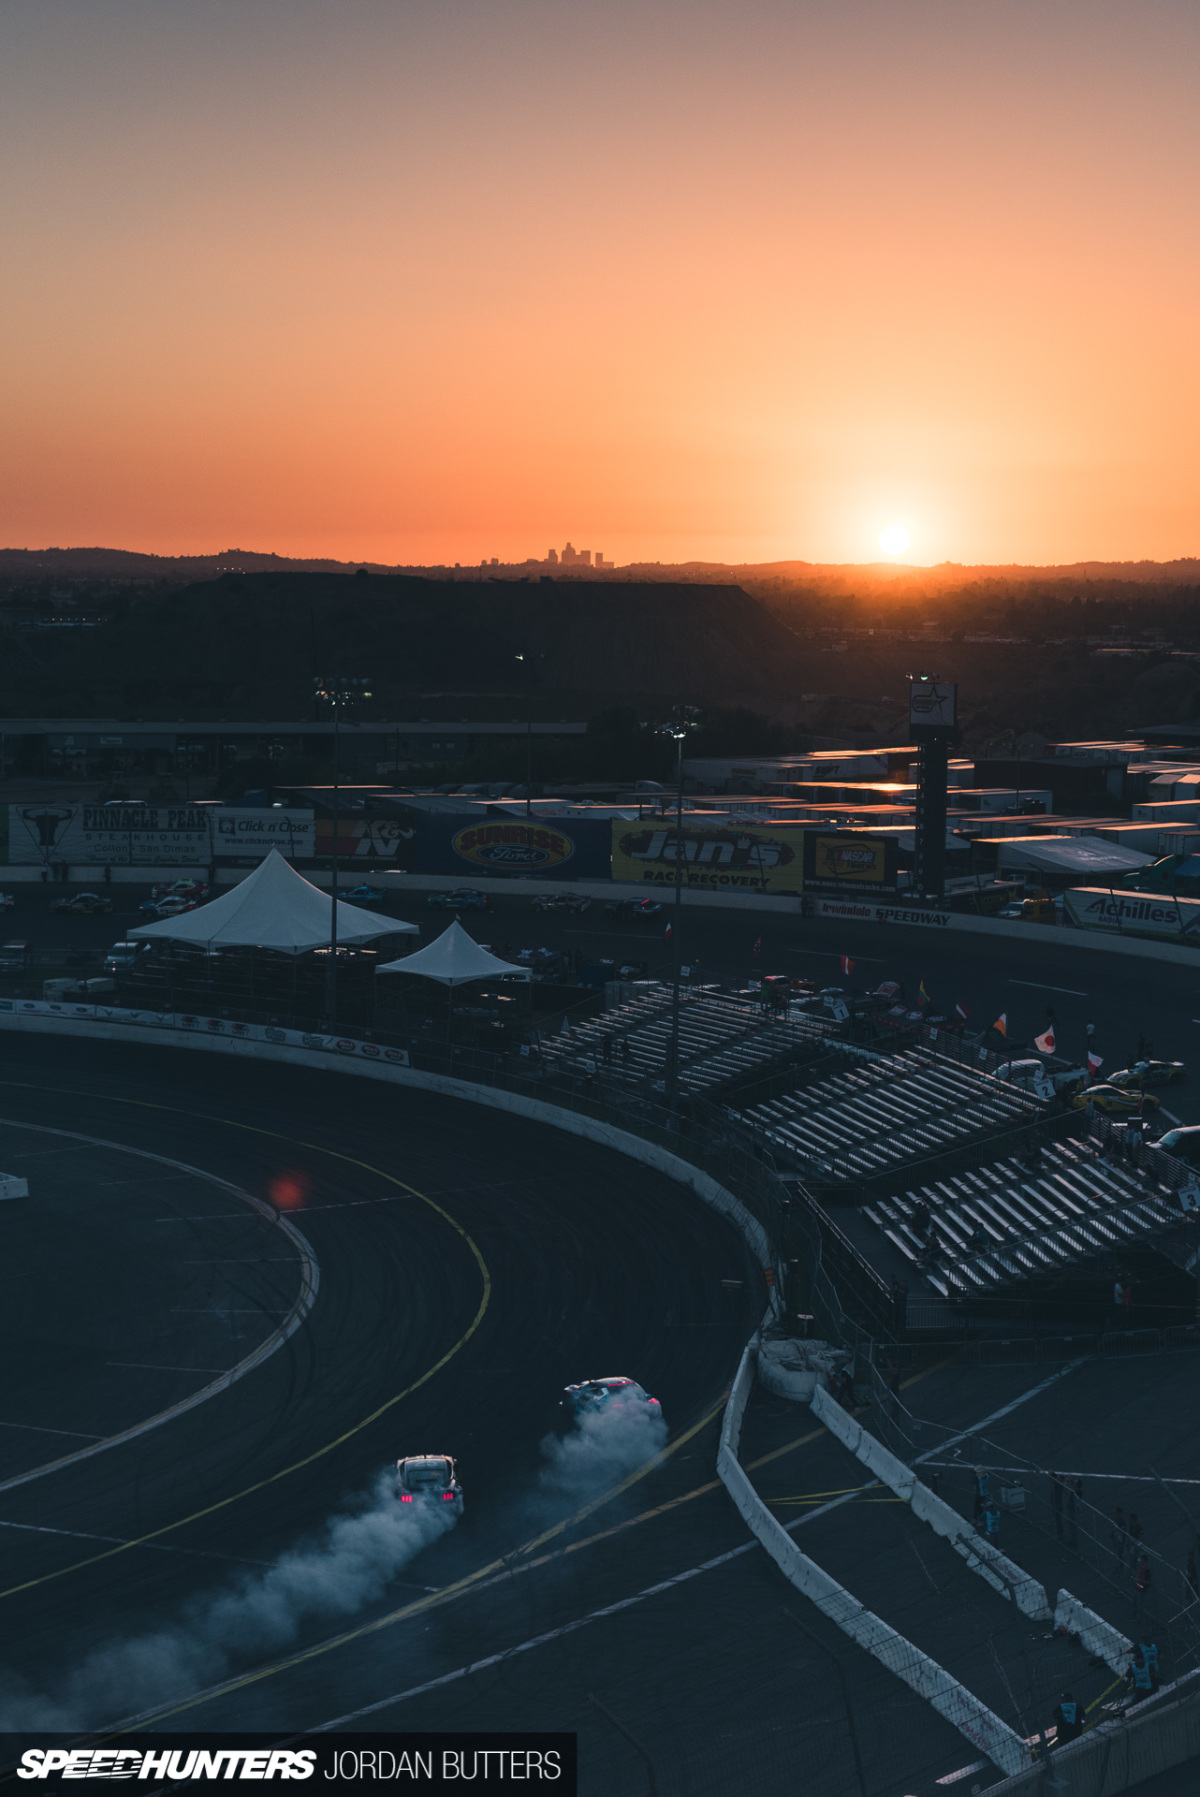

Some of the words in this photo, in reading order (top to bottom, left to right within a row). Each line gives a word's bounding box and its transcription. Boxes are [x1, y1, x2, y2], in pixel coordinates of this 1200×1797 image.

[83, 809, 158, 827] PINNACLE
[168, 810, 206, 828] PEAK
[238, 820, 264, 832] Click
[279, 820, 308, 833] Close
[85, 833, 205, 841] STEAKHOUSE
[460, 825, 565, 857] SUNRISE
[140, 845, 160, 853] San
[164, 845, 196, 853] Dimas
[490, 846, 537, 860] Ford
[631, 831, 782, 866] Jan's
[841, 851, 874, 863] NASCAR
[643, 870, 683, 883] RACE
[688, 872, 770, 889] RECOVERY
[822, 903, 871, 917] Irwindale
[876, 908, 950, 926] SPEEDWAY
[1085, 898, 1178, 923] Achilles
[1042, 1086, 1050, 1097] 2
[1187, 1194, 1196, 1207] 3
